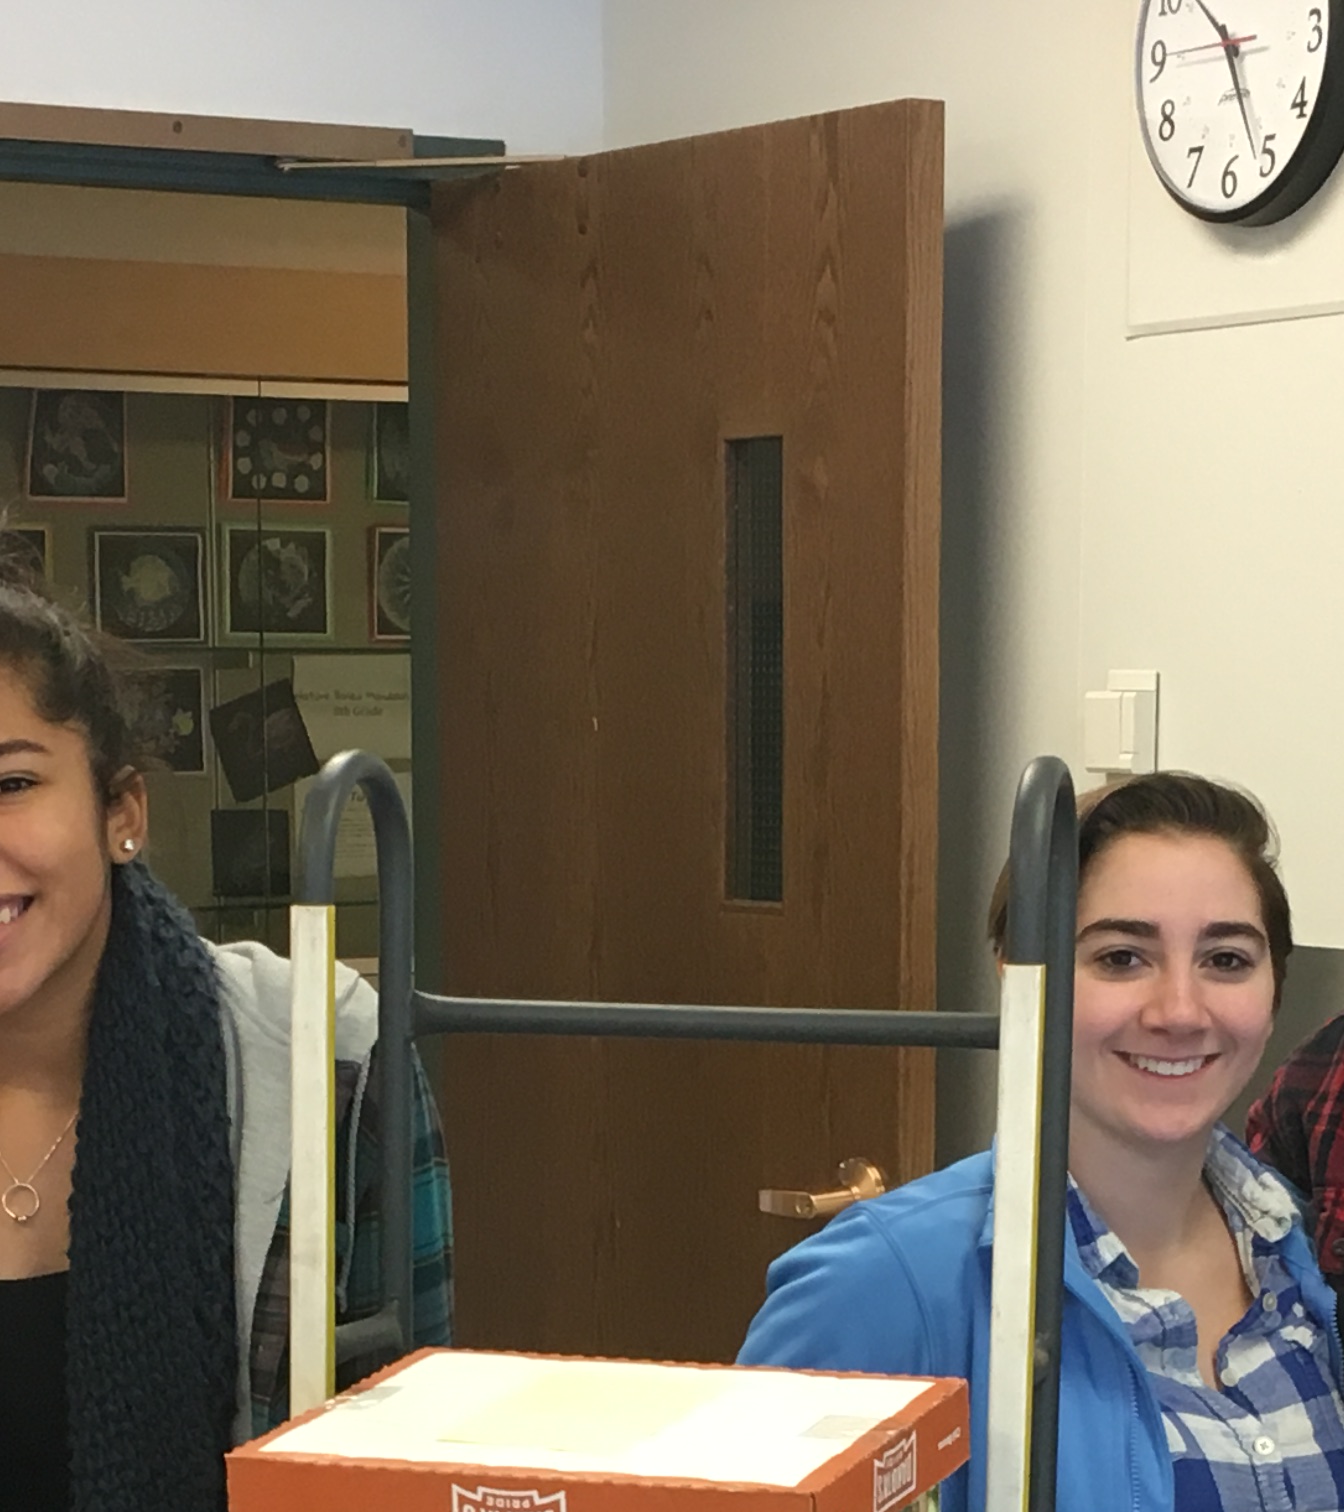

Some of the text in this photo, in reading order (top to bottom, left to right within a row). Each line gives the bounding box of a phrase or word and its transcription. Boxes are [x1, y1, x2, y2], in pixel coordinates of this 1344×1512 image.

[1307, 8, 1323, 53] 3
[1149, 40, 1167, 84] 9
[1289, 75, 1308, 120] 4
[1158, 99, 1176, 142] 8
[1186, 145, 1205, 189] 7
[1220, 154, 1239, 199] 6
[1258, 133, 1277, 178] 5
[486, 1495, 531, 1509] PRIDE
